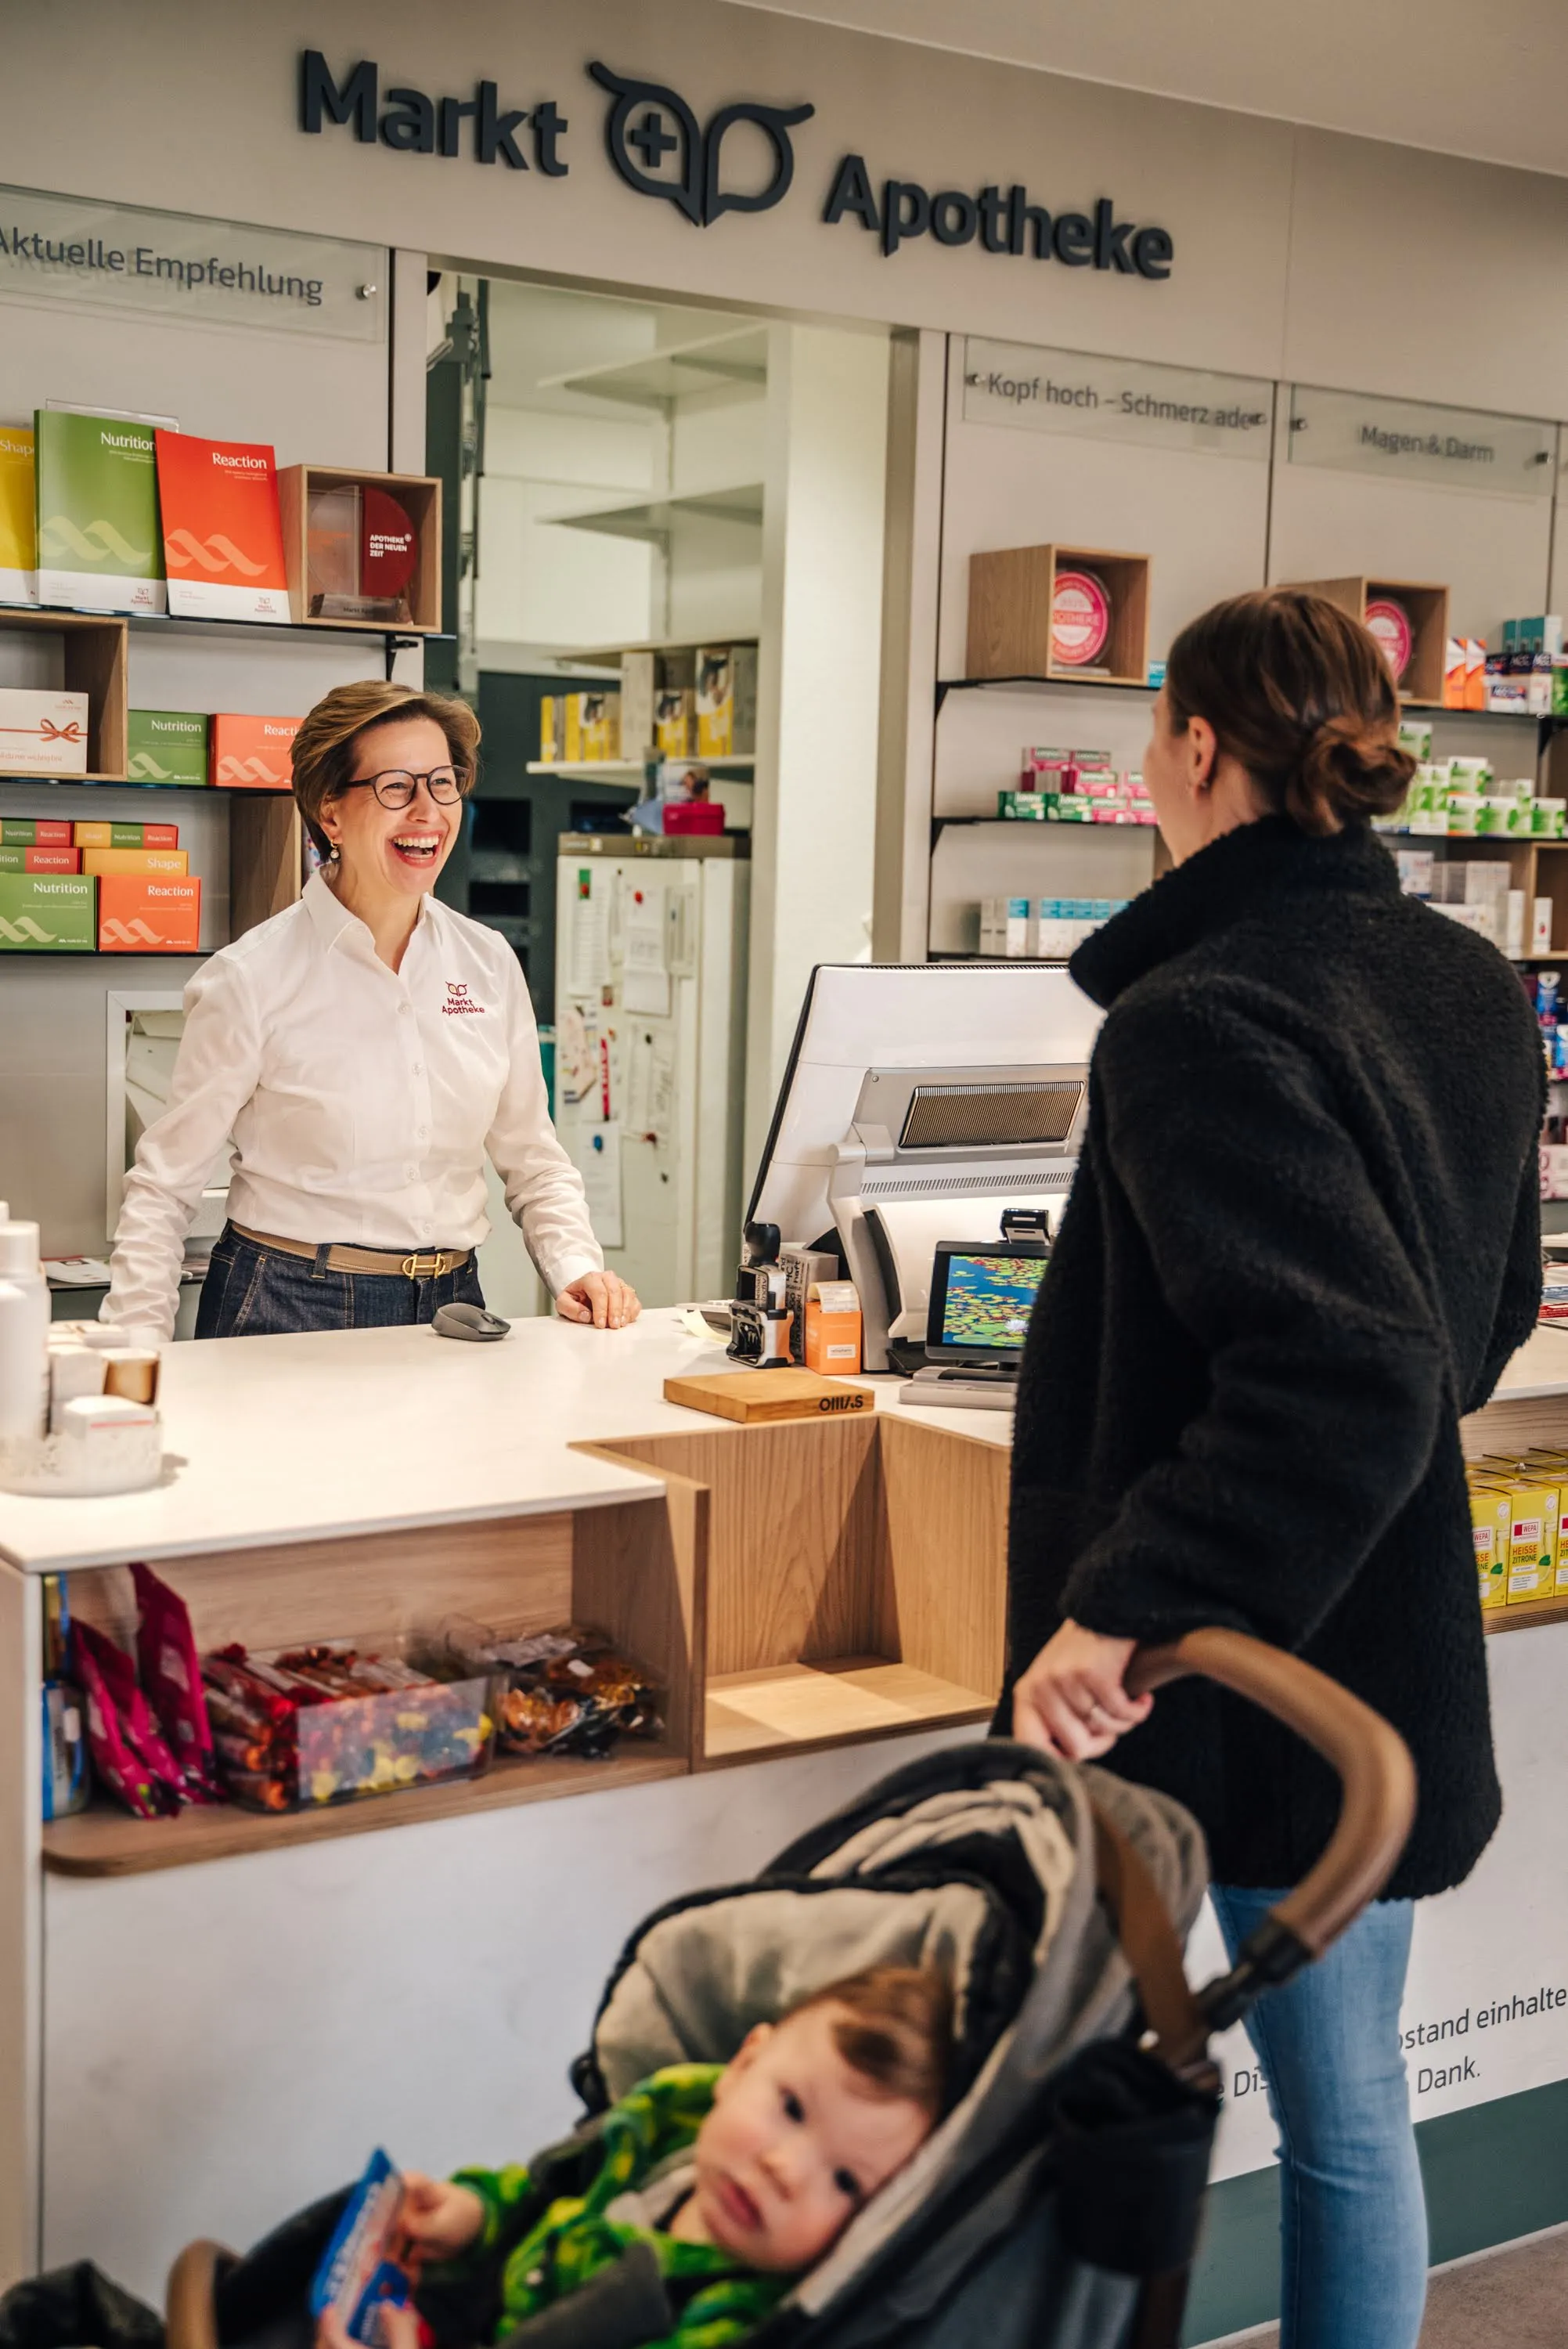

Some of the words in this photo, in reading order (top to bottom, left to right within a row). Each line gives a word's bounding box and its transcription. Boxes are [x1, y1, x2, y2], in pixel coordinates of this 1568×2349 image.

[302, 49, 569, 177] Markt
[823, 153, 1173, 280] Apotheke
[135, 247, 323, 307] Empfehlung
[988, 372, 1040, 406] Kopf
[1046, 379, 1098, 409] hoch
[1121, 391, 1209, 424] Schmerz
[101, 431, 157, 451] Nutrition
[1361, 425, 1424, 455] Magen
[1427, 433, 1440, 455] &
[1445, 436, 1494, 464] Darm
[212, 452, 268, 470] Reaction
[369, 534, 405, 544] APOTHEKE
[384, 543, 407, 552] NEUEN
[151, 720, 202, 733] Nutrition
[5, 829, 33, 838] Nutrition
[39, 830, 67, 839] Reaction
[147, 834, 173, 843] Reaction
[33, 855, 70, 865] Reaction
[147, 857, 182, 870] Shape
[33, 882, 88, 894] Nutrition
[147, 885, 194, 897] Reaction
[447, 998, 474, 1006] Markt
[442, 1005, 485, 1016] Apotheke
[1474, 1532, 1488, 1541] WEPA
[1512, 1544, 1538, 1556] HEISSE
[1512, 1553, 1537, 1564] ZITRONE
[1476, 1987, 1567, 2029] einhalte
[1417, 2055, 1481, 2094] Dank.
